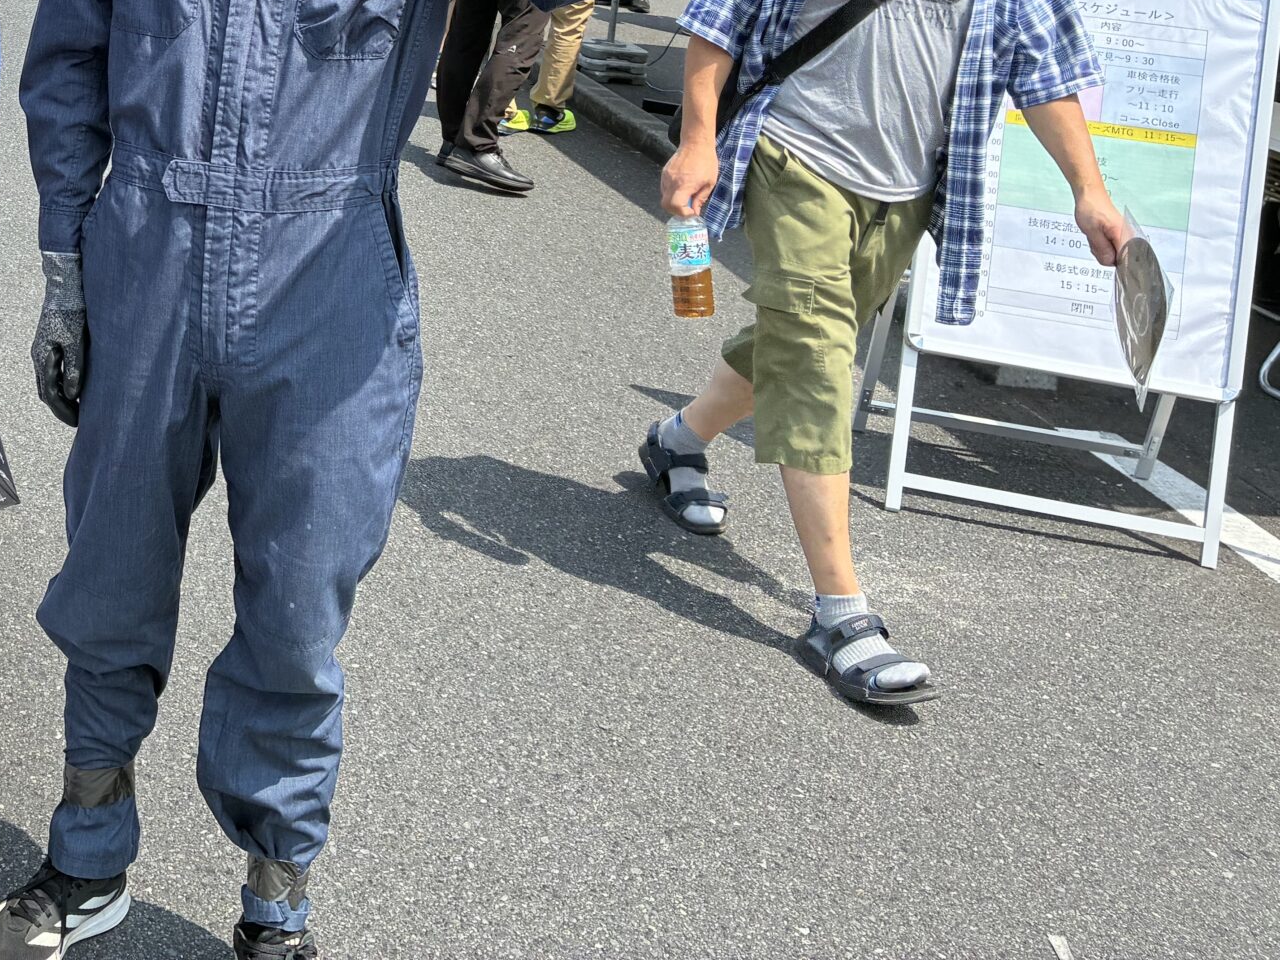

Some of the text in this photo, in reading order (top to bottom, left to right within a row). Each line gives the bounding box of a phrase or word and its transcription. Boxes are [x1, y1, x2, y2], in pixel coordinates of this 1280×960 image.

[1126, 85, 1179, 100] フリー走行
[679, 243, 707, 259] 麦茶
